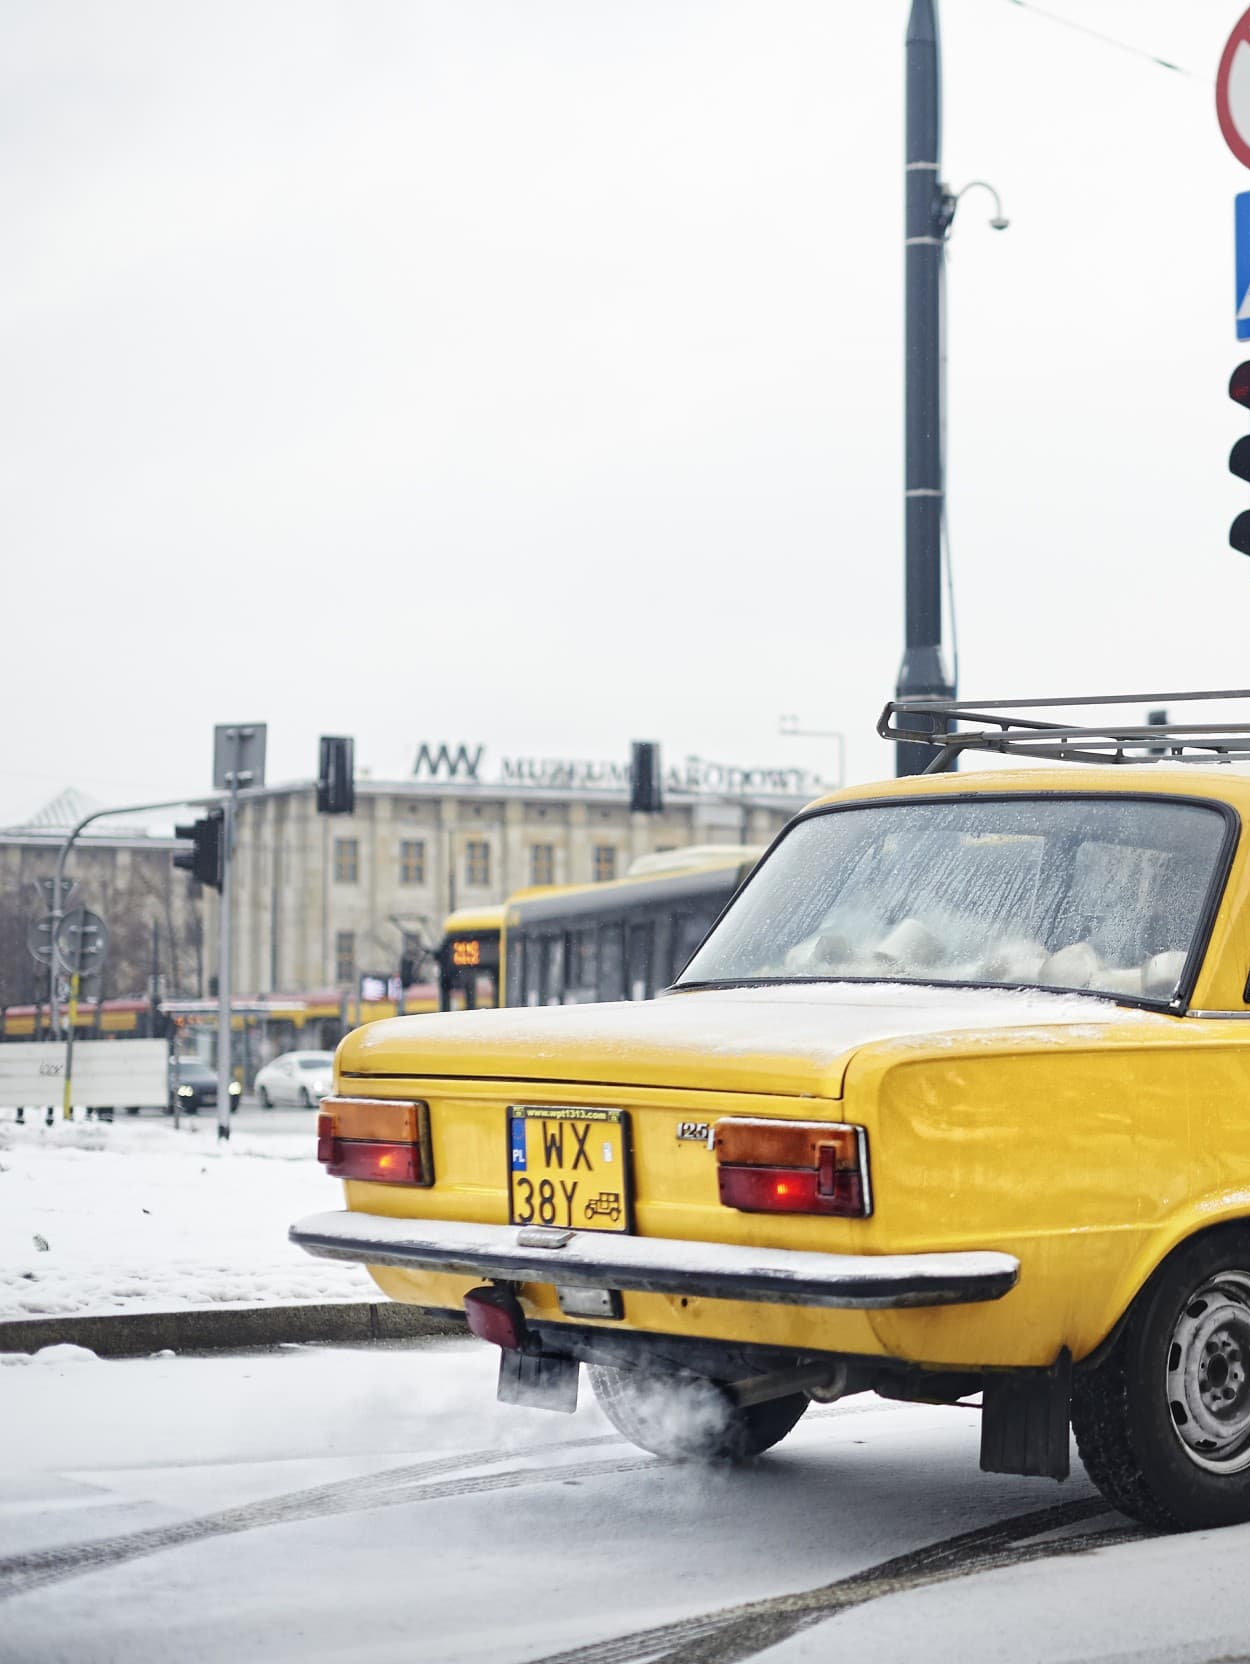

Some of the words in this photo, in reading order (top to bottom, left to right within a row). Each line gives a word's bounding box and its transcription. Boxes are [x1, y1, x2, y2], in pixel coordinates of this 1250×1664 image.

[512, 1148, 526, 1163] PL
[541, 1121, 594, 1172] WX
[516, 1177, 578, 1227] 38Y
